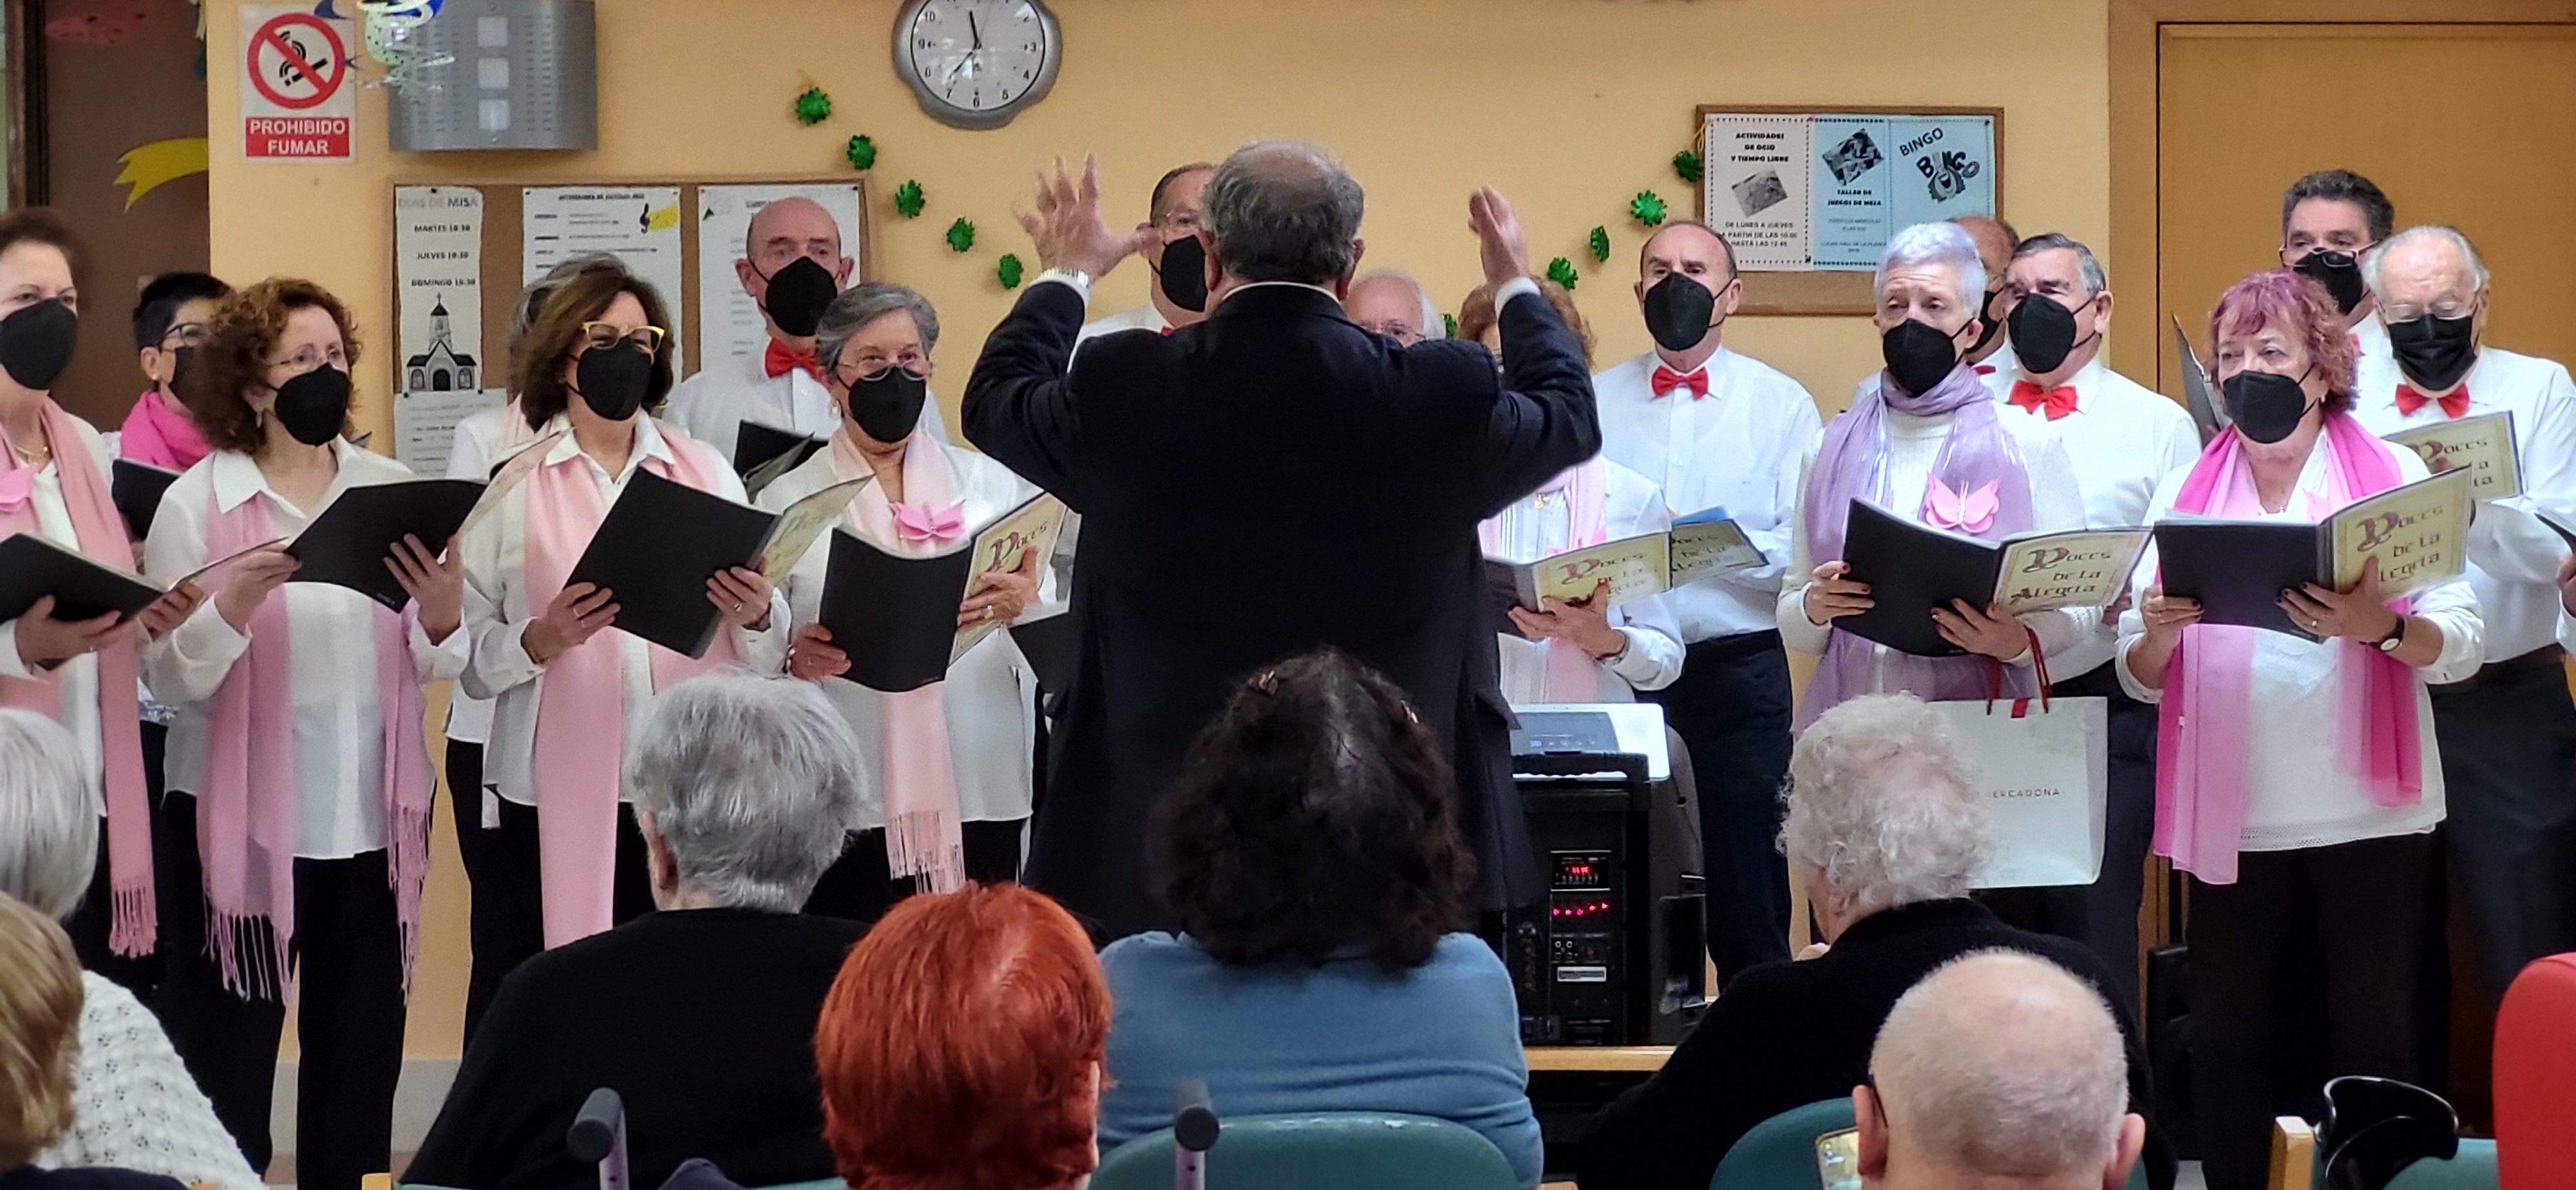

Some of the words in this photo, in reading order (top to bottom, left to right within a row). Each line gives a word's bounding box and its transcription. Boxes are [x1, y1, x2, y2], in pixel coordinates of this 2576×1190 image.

[925, 12, 935, 22] 10
[918, 39, 925, 49] 9
[1030, 42, 1036, 52] 3
[1023, 70, 1029, 80] 4
[946, 88, 952, 99] 7
[250, 120, 345, 135] PROHIBIDO
[1899, 127, 1944, 156] BINGO
[268, 139, 328, 155] FUMAR
[448, 196, 478, 207] MISA
[417, 251, 445, 260] JUEVES
[412, 279, 452, 287] DOMINGO
[2022, 547, 2112, 573] Voces
[2381, 552, 2440, 583] legria
[1993, 788, 2060, 798] ERCADONA
